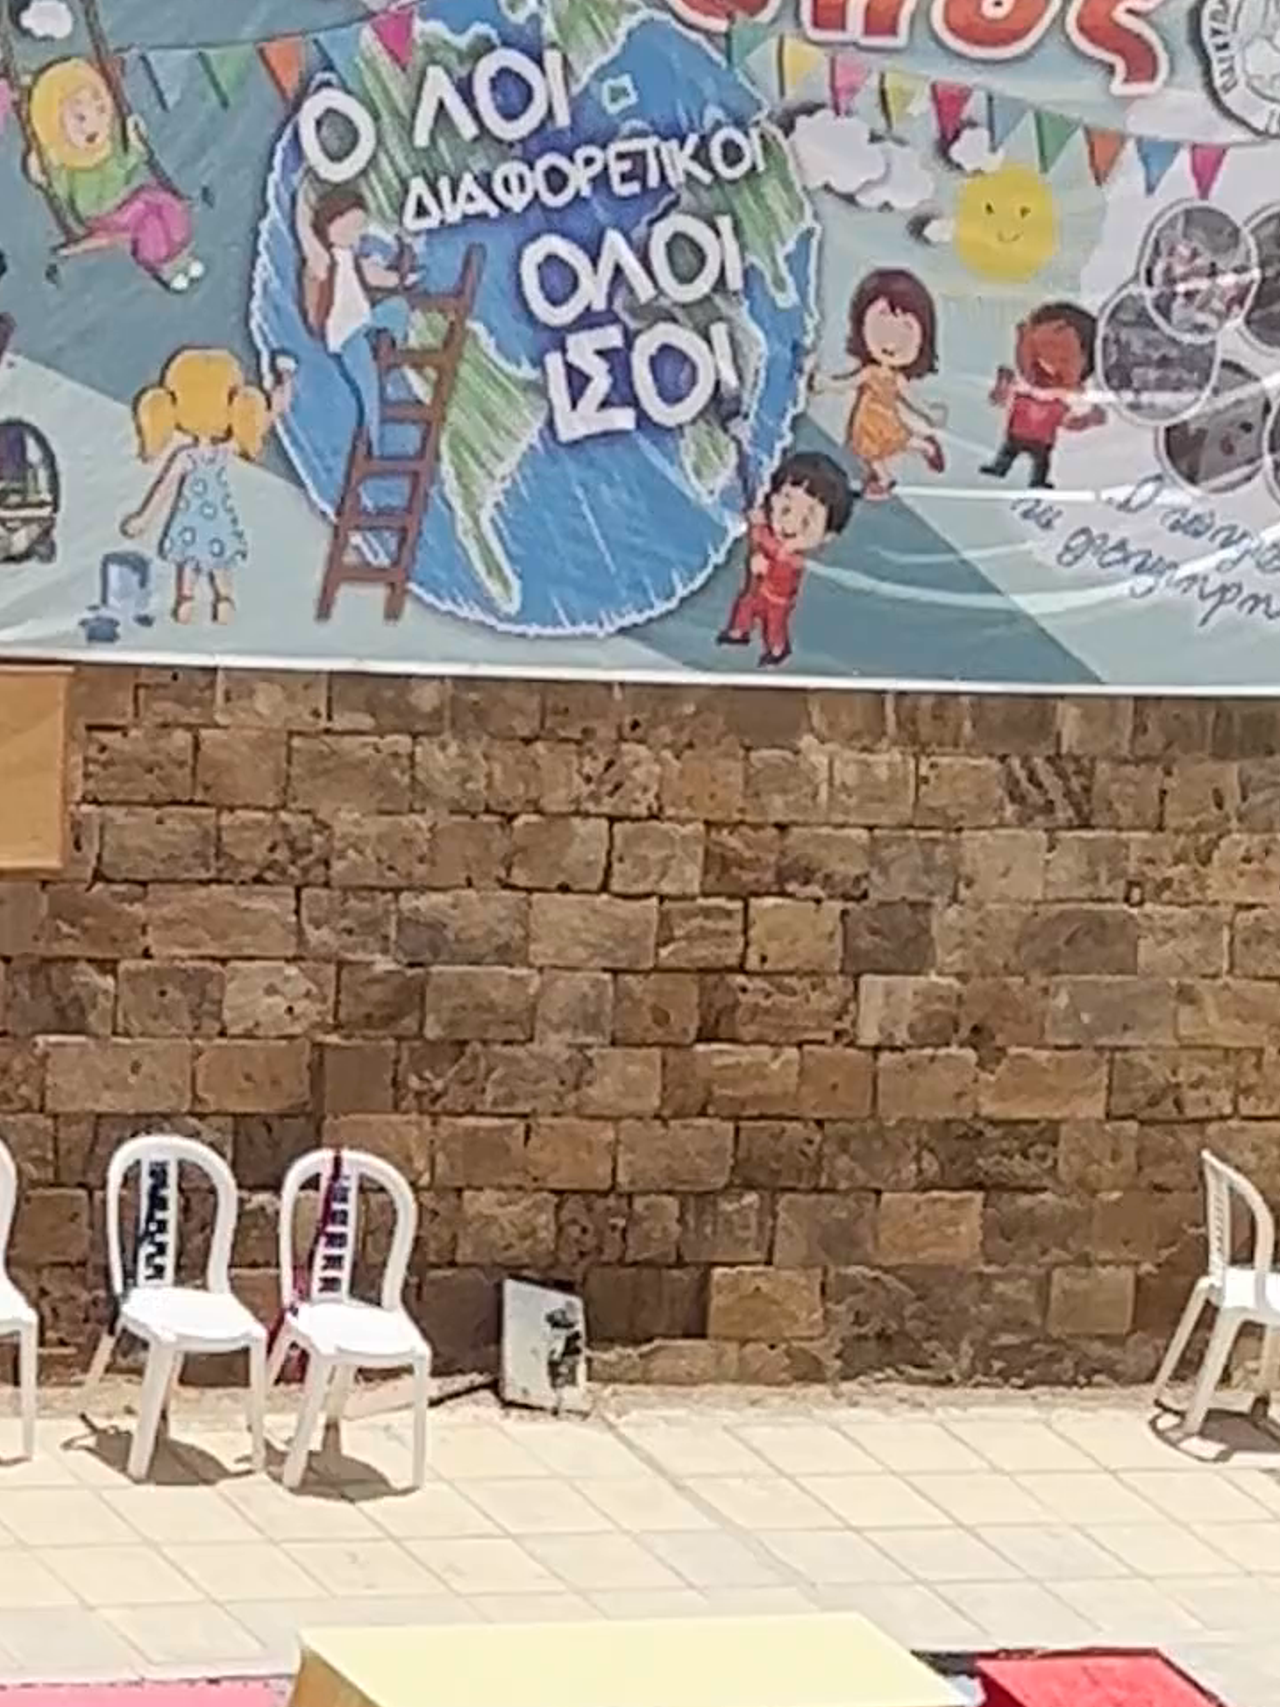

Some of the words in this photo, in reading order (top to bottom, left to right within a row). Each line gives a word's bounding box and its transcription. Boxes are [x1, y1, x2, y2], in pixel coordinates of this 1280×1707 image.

[402, 121, 766, 231] ΔΙΑΦΟΡΕΤΙΚΟΙ
[519, 215, 745, 327] ΟΛΟΙ
[543, 321, 742, 443] ΙΣΟΙ
